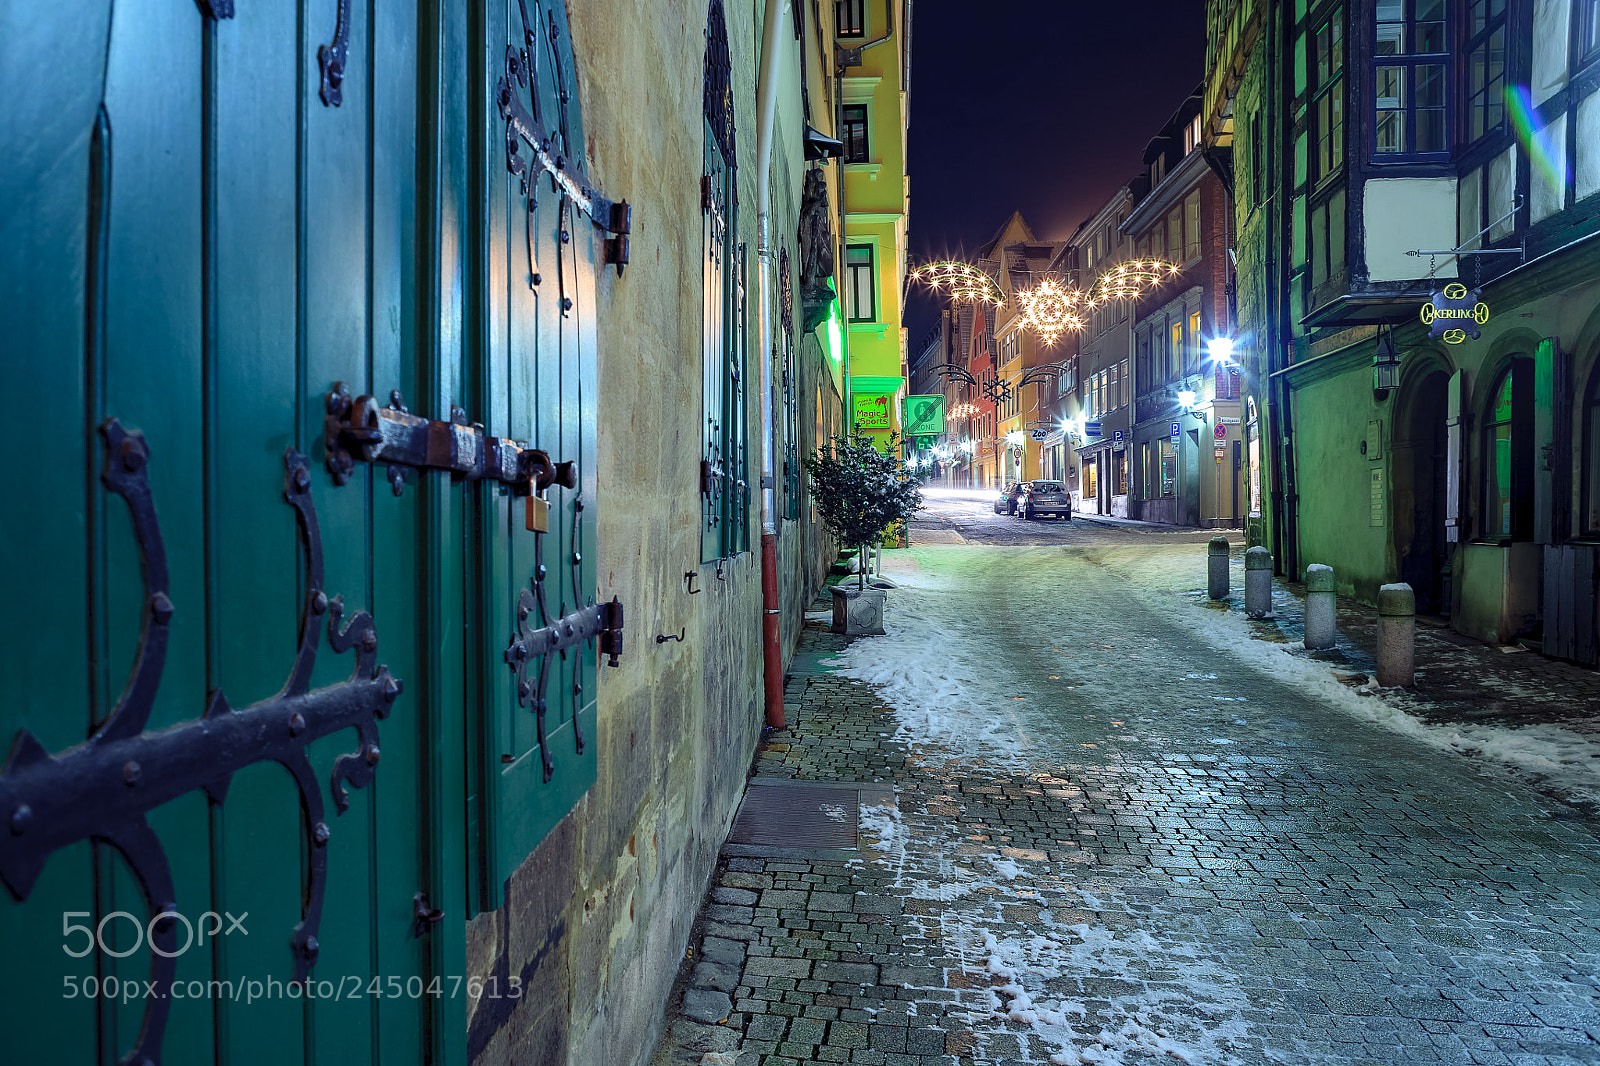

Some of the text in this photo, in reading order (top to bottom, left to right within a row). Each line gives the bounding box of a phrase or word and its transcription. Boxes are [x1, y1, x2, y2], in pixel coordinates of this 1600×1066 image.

[1434, 309, 1475, 319] KERLING
[856, 409, 880, 419] Magic
[859, 417, 888, 427] Sports
[1032, 429, 1047, 438] Zoo
